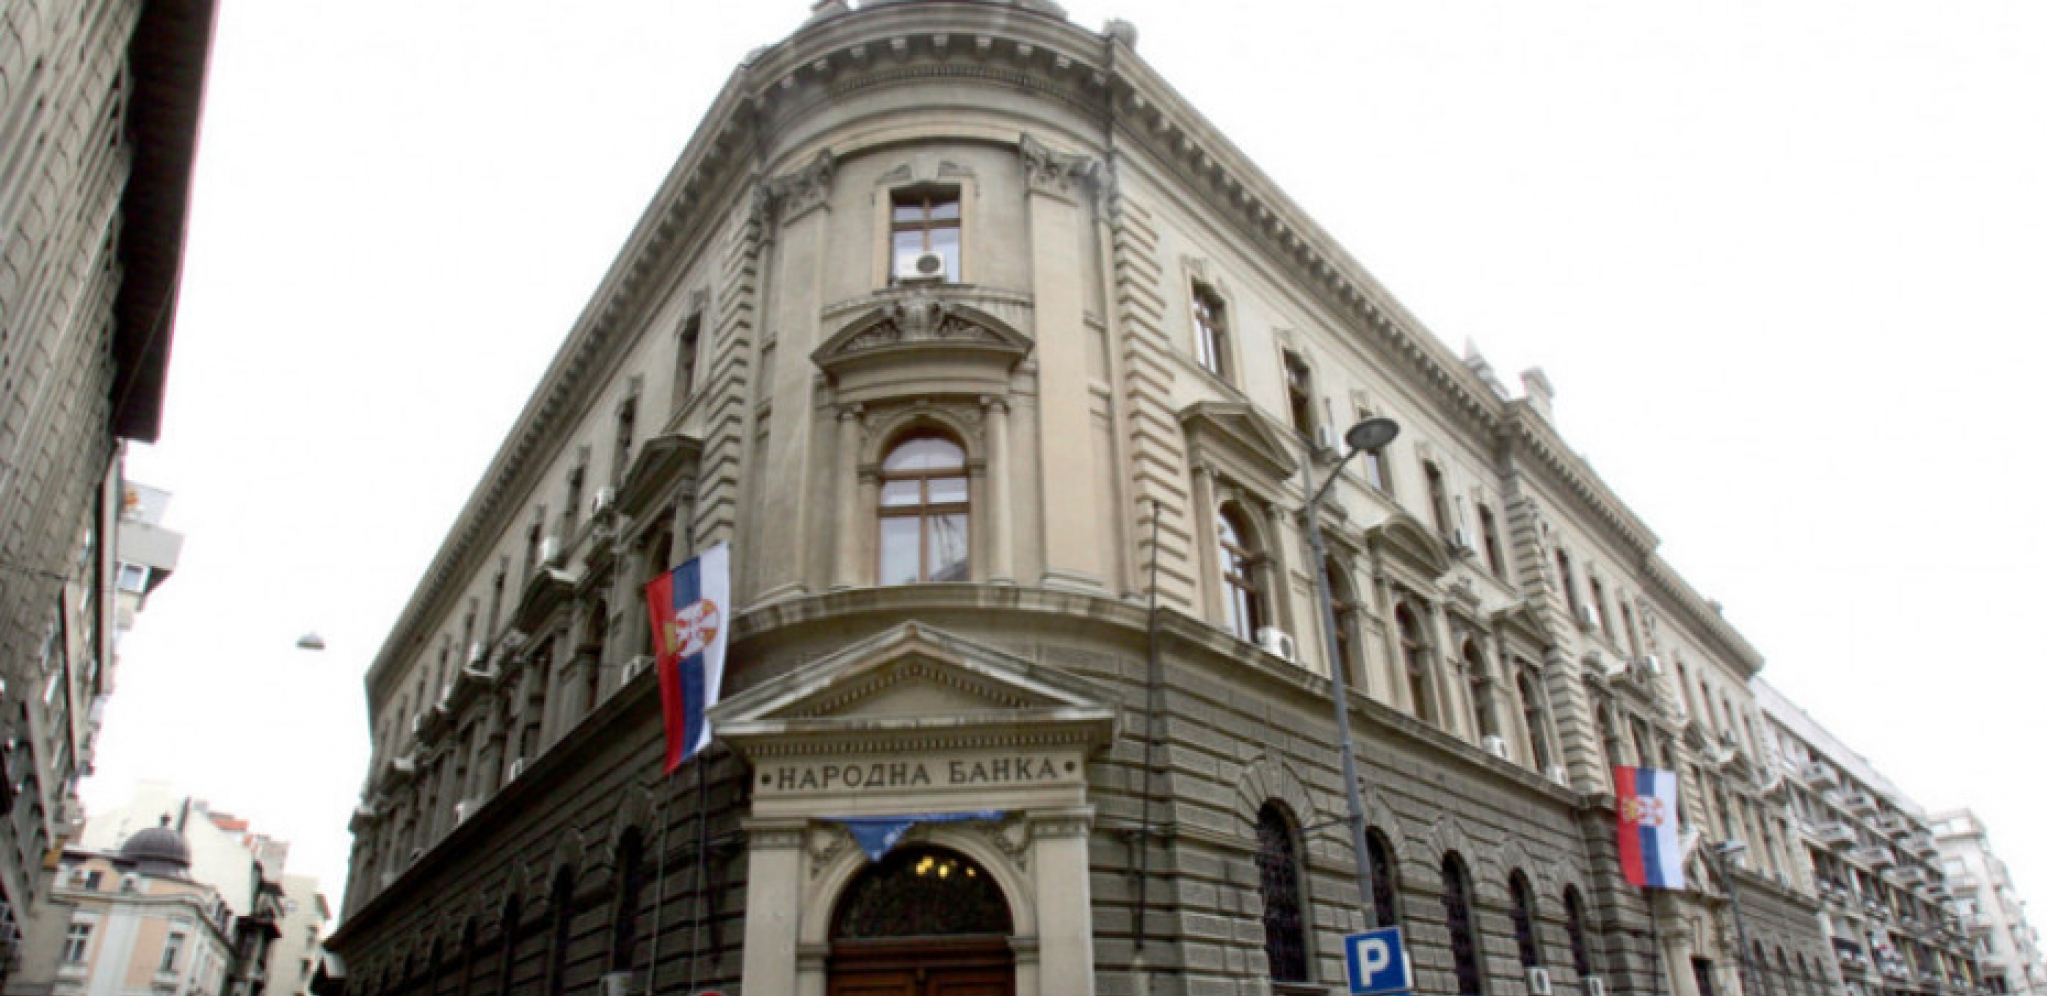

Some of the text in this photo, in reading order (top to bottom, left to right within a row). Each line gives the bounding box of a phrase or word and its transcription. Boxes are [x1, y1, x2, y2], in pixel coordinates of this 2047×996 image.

[777, 757, 1059, 790] НАРОДНА БАНКА
[1357, 938, 1390, 987] P
